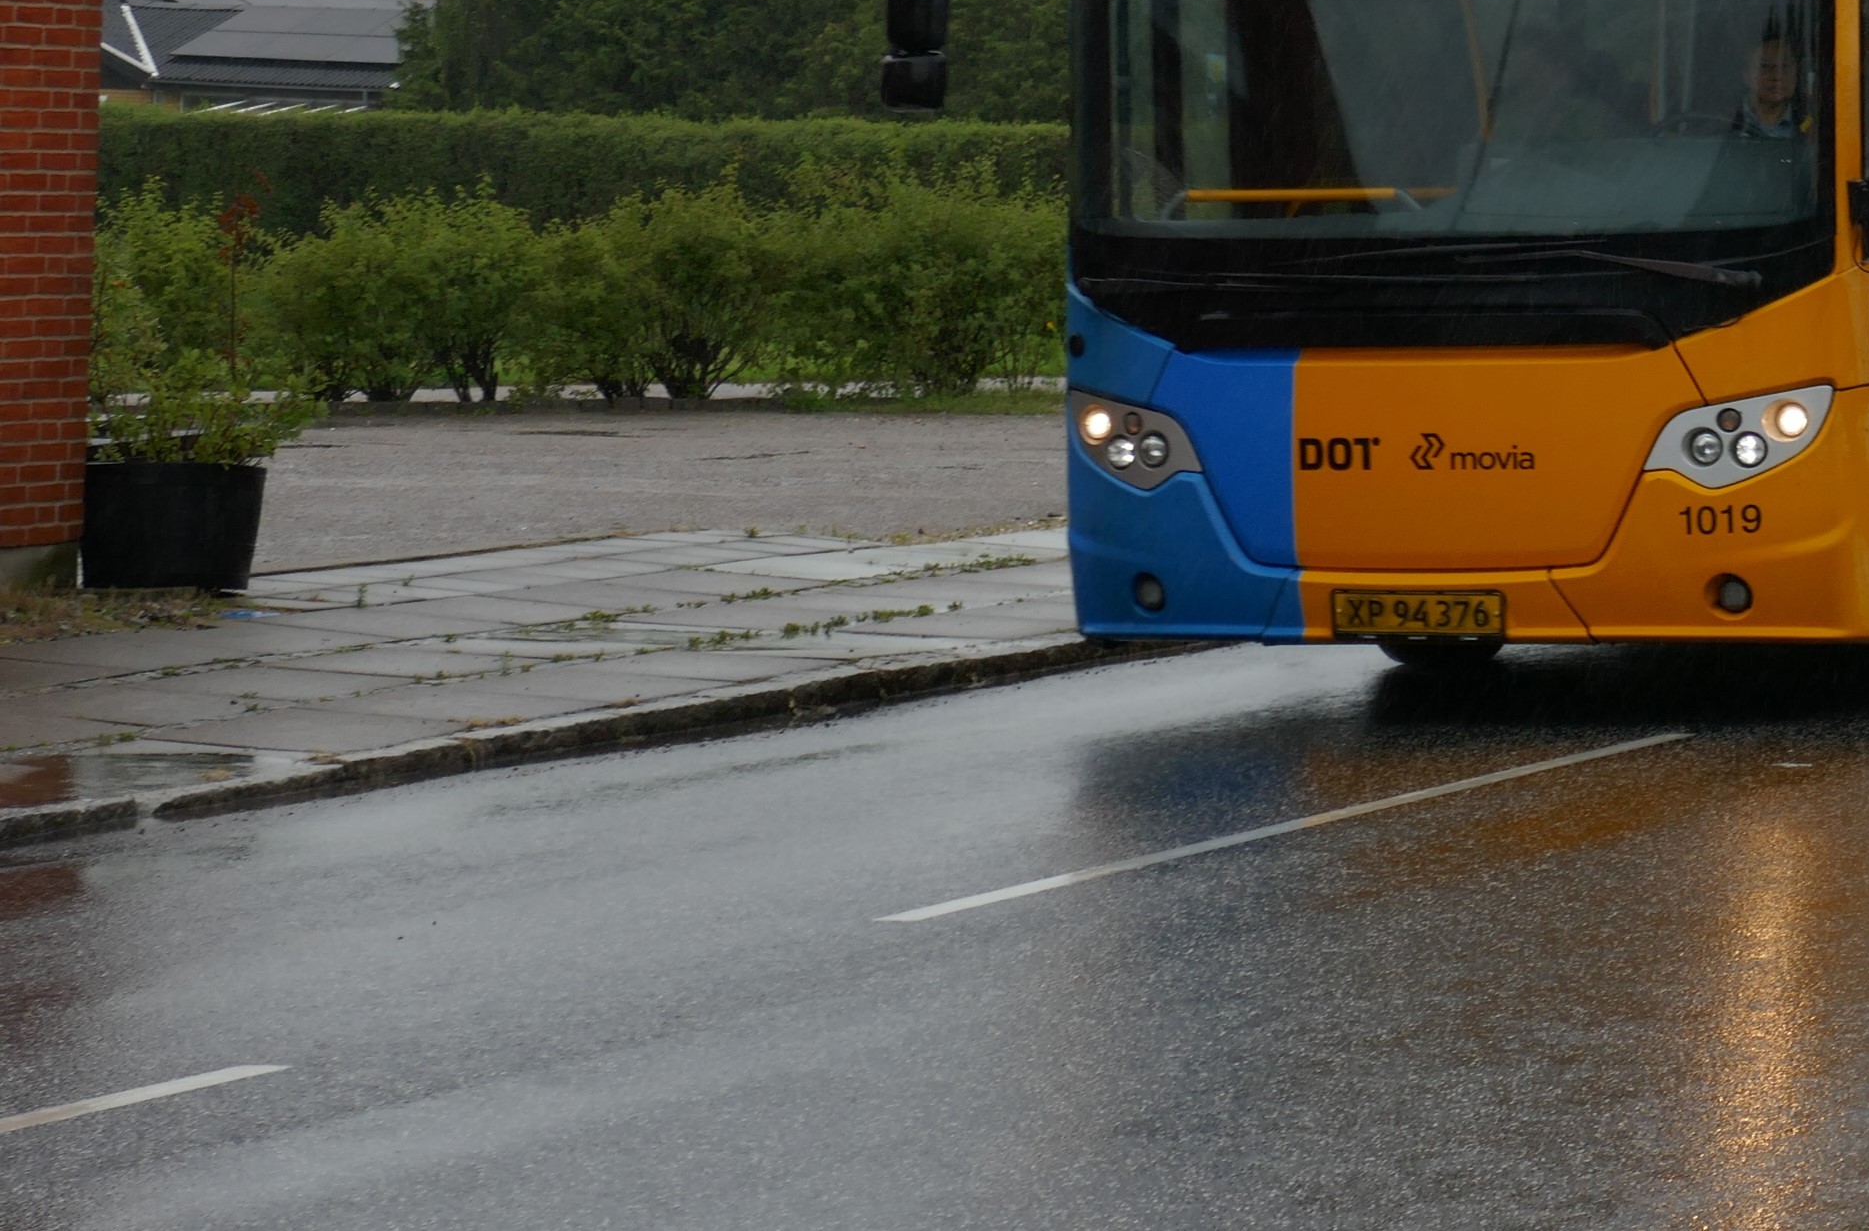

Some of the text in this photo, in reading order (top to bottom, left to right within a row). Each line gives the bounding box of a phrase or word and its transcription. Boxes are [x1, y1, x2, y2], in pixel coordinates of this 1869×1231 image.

[1298, 437, 1380, 471] DOT
[1450, 445, 1535, 470] movia
[1679, 504, 1762, 535] 1019
[1346, 599, 1490, 628] XP 94 376
